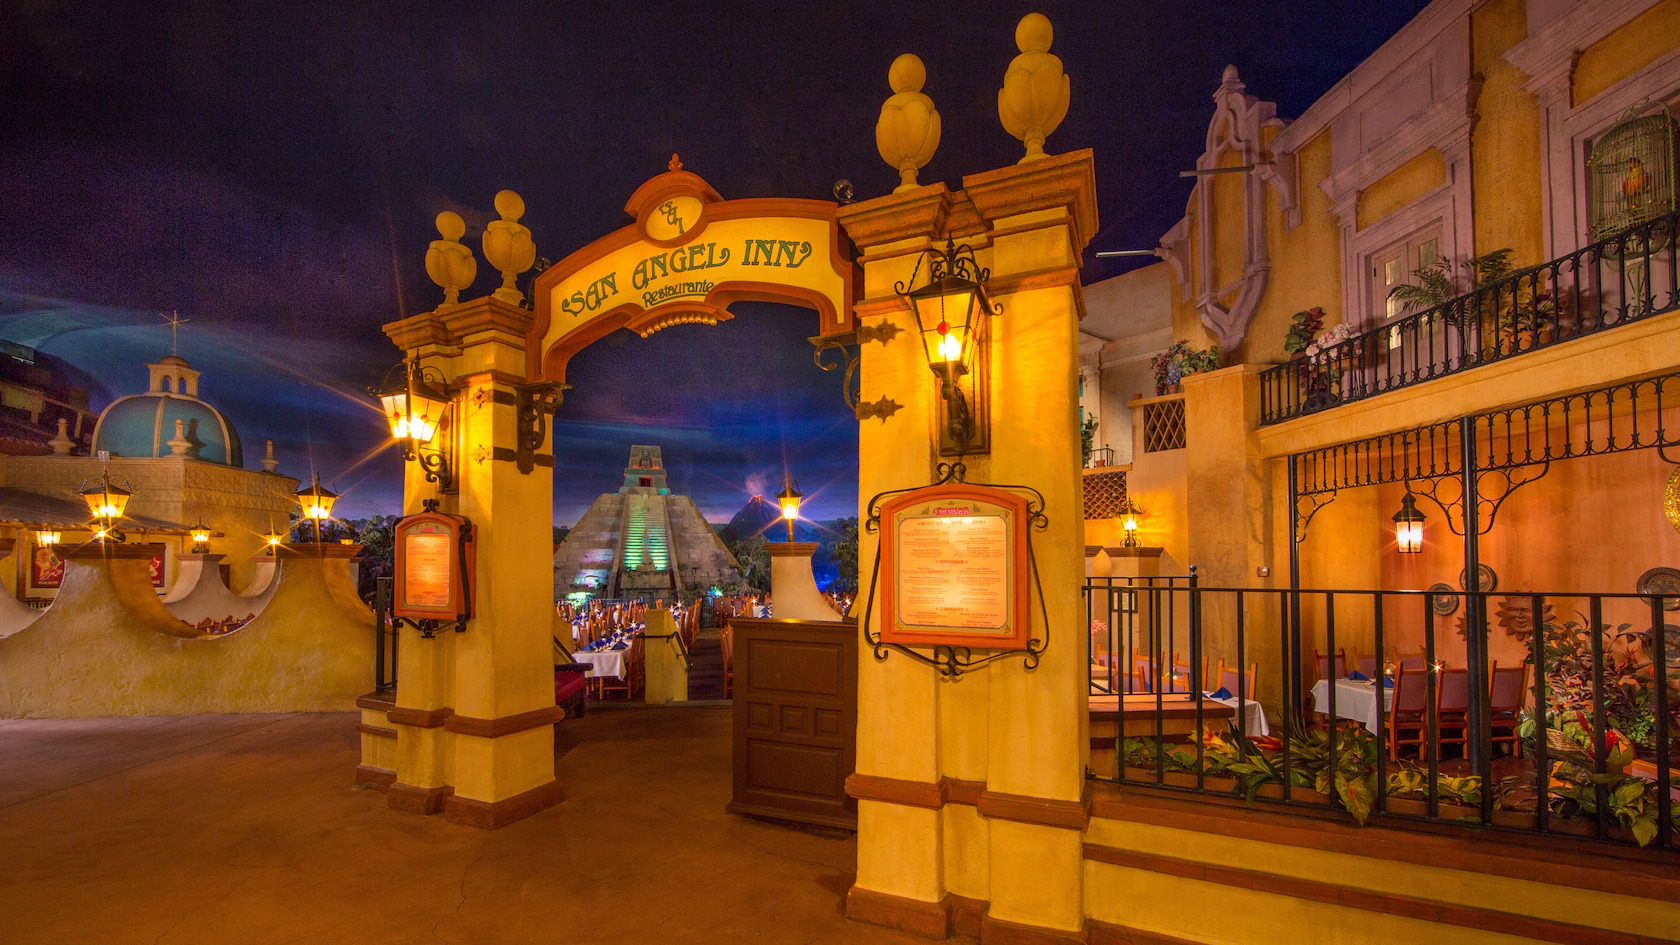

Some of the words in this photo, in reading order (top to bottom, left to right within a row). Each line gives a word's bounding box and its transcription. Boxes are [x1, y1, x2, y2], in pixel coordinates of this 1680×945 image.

[561, 271, 618, 317] SAN
[632, 242, 730, 290] ANGEL
[742, 239, 812, 268] INN
[642, 278, 715, 308] Restaurante
